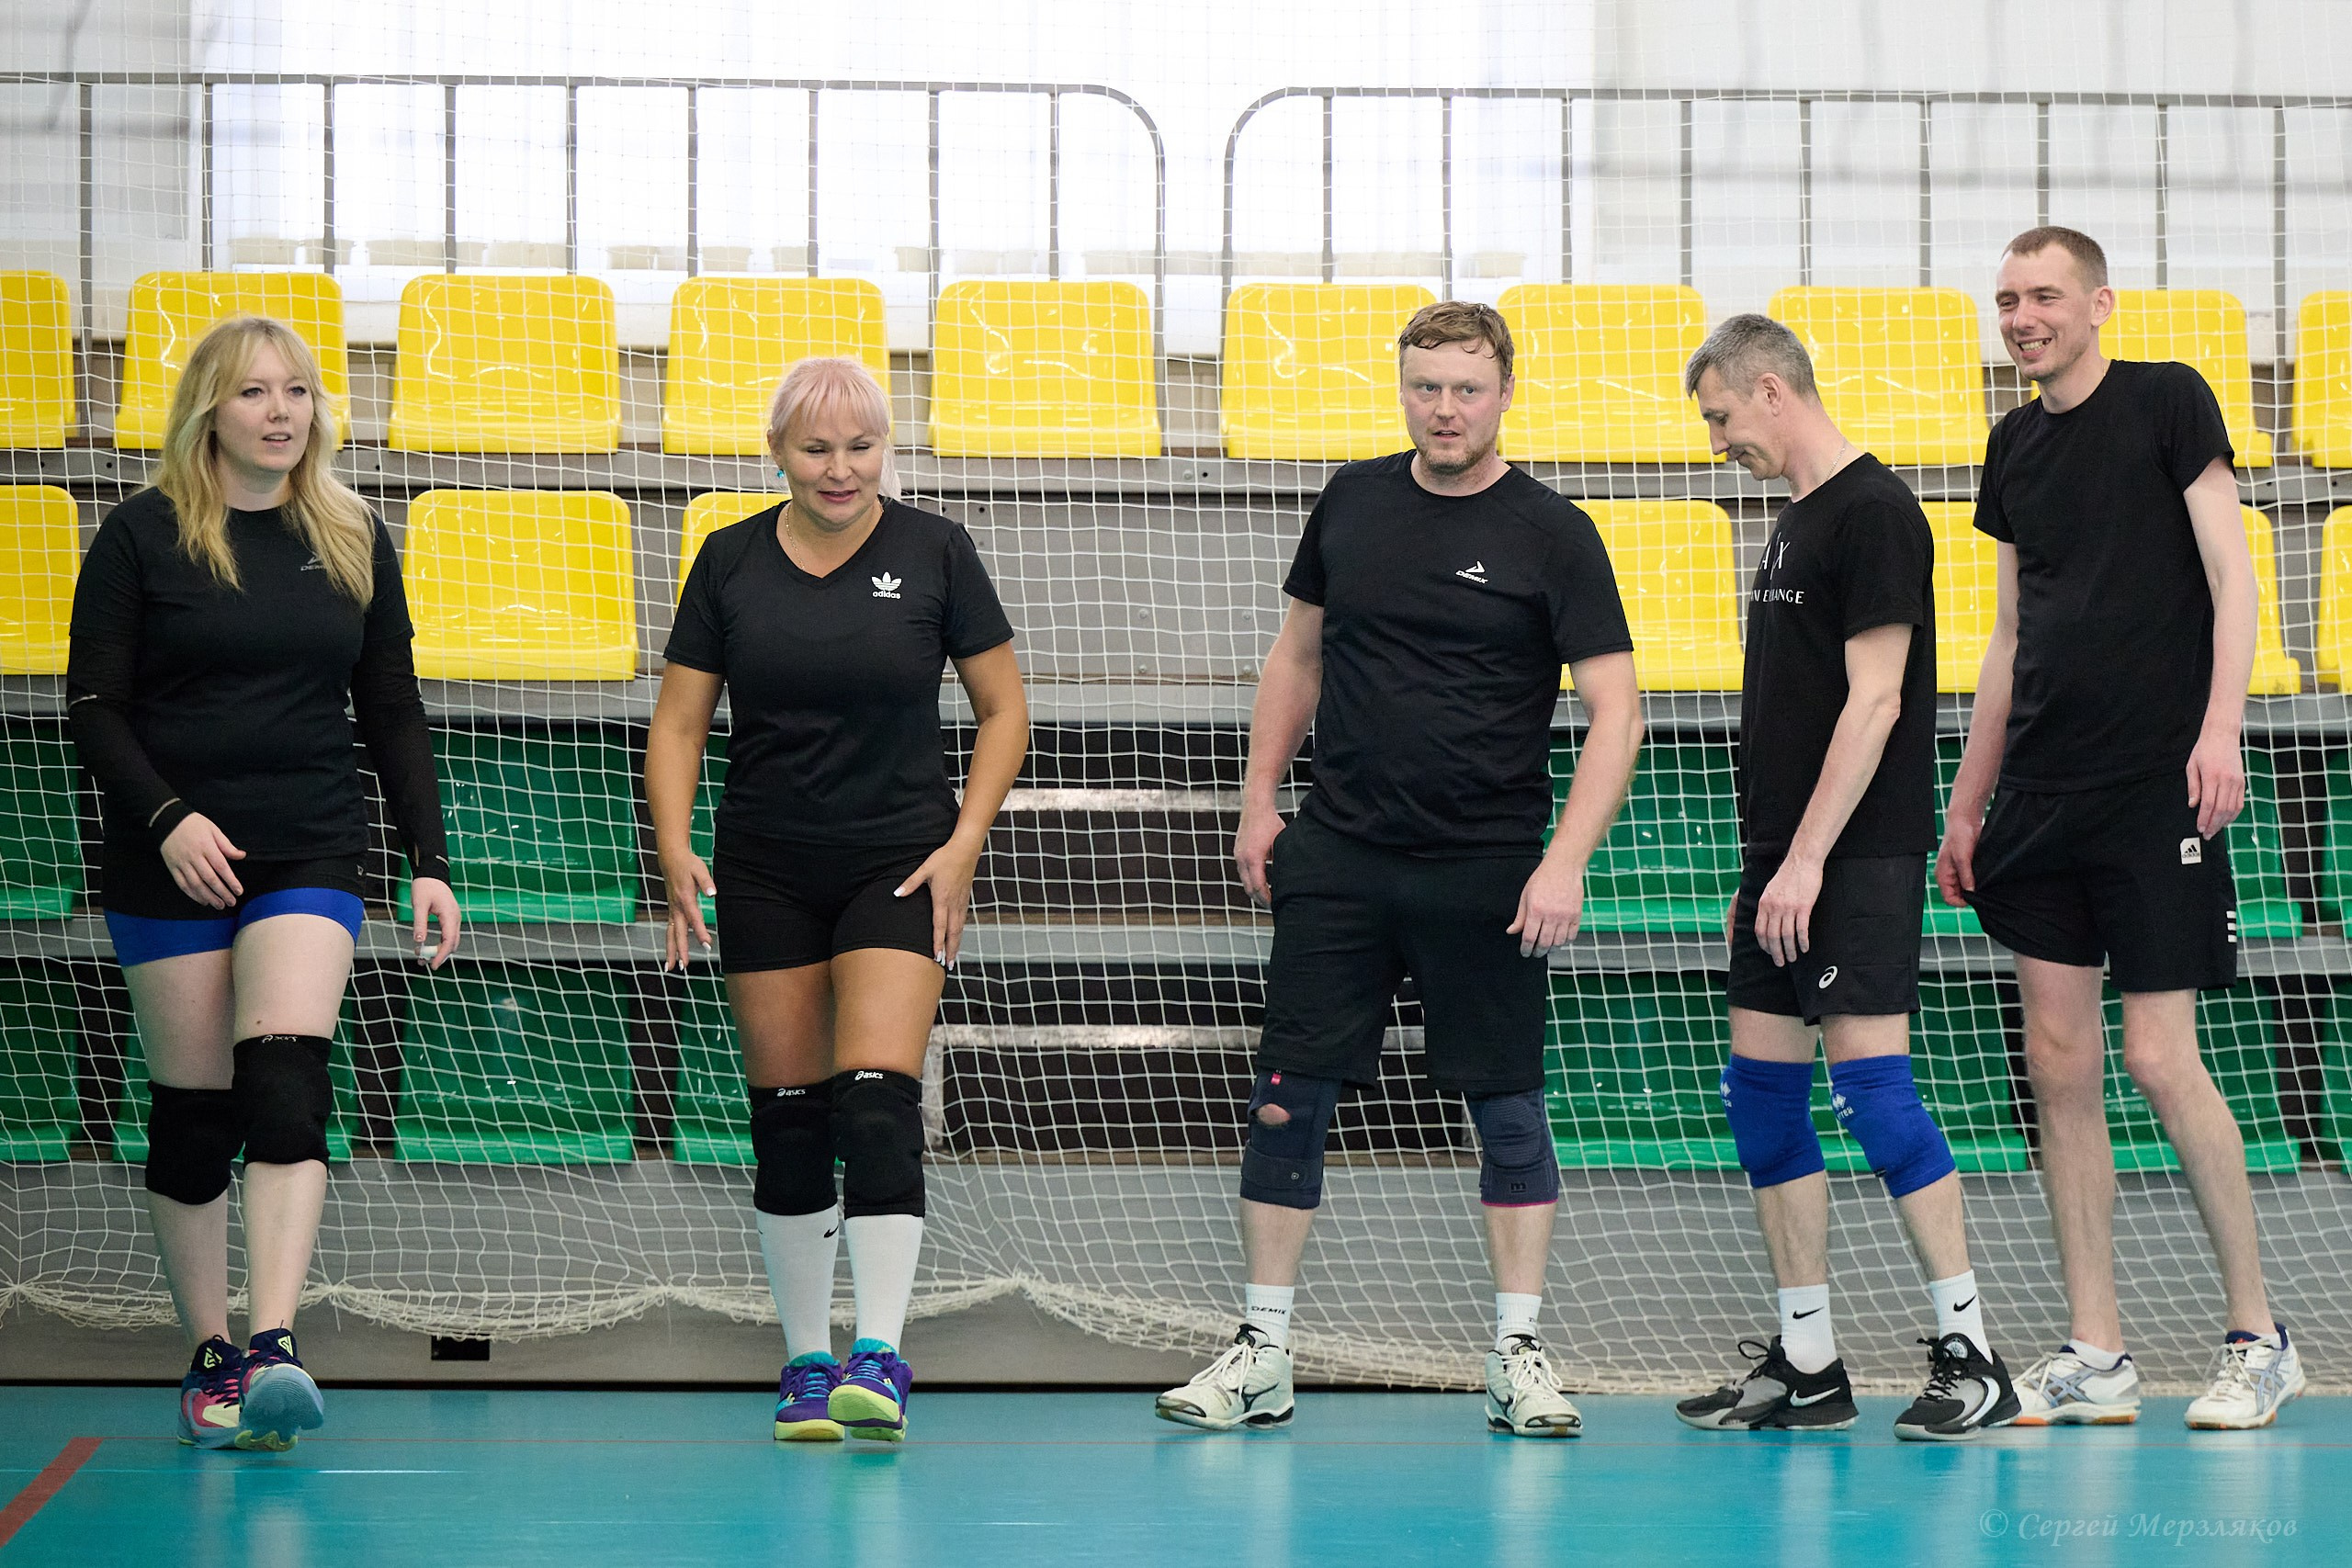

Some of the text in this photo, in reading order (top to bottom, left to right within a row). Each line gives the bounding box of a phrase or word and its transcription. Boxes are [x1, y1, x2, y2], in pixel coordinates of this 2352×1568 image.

[872, 590, 901, 599] adidas
[863, 1071, 884, 1079] asics
[1250, 1305, 1286, 1314] DEMIX
